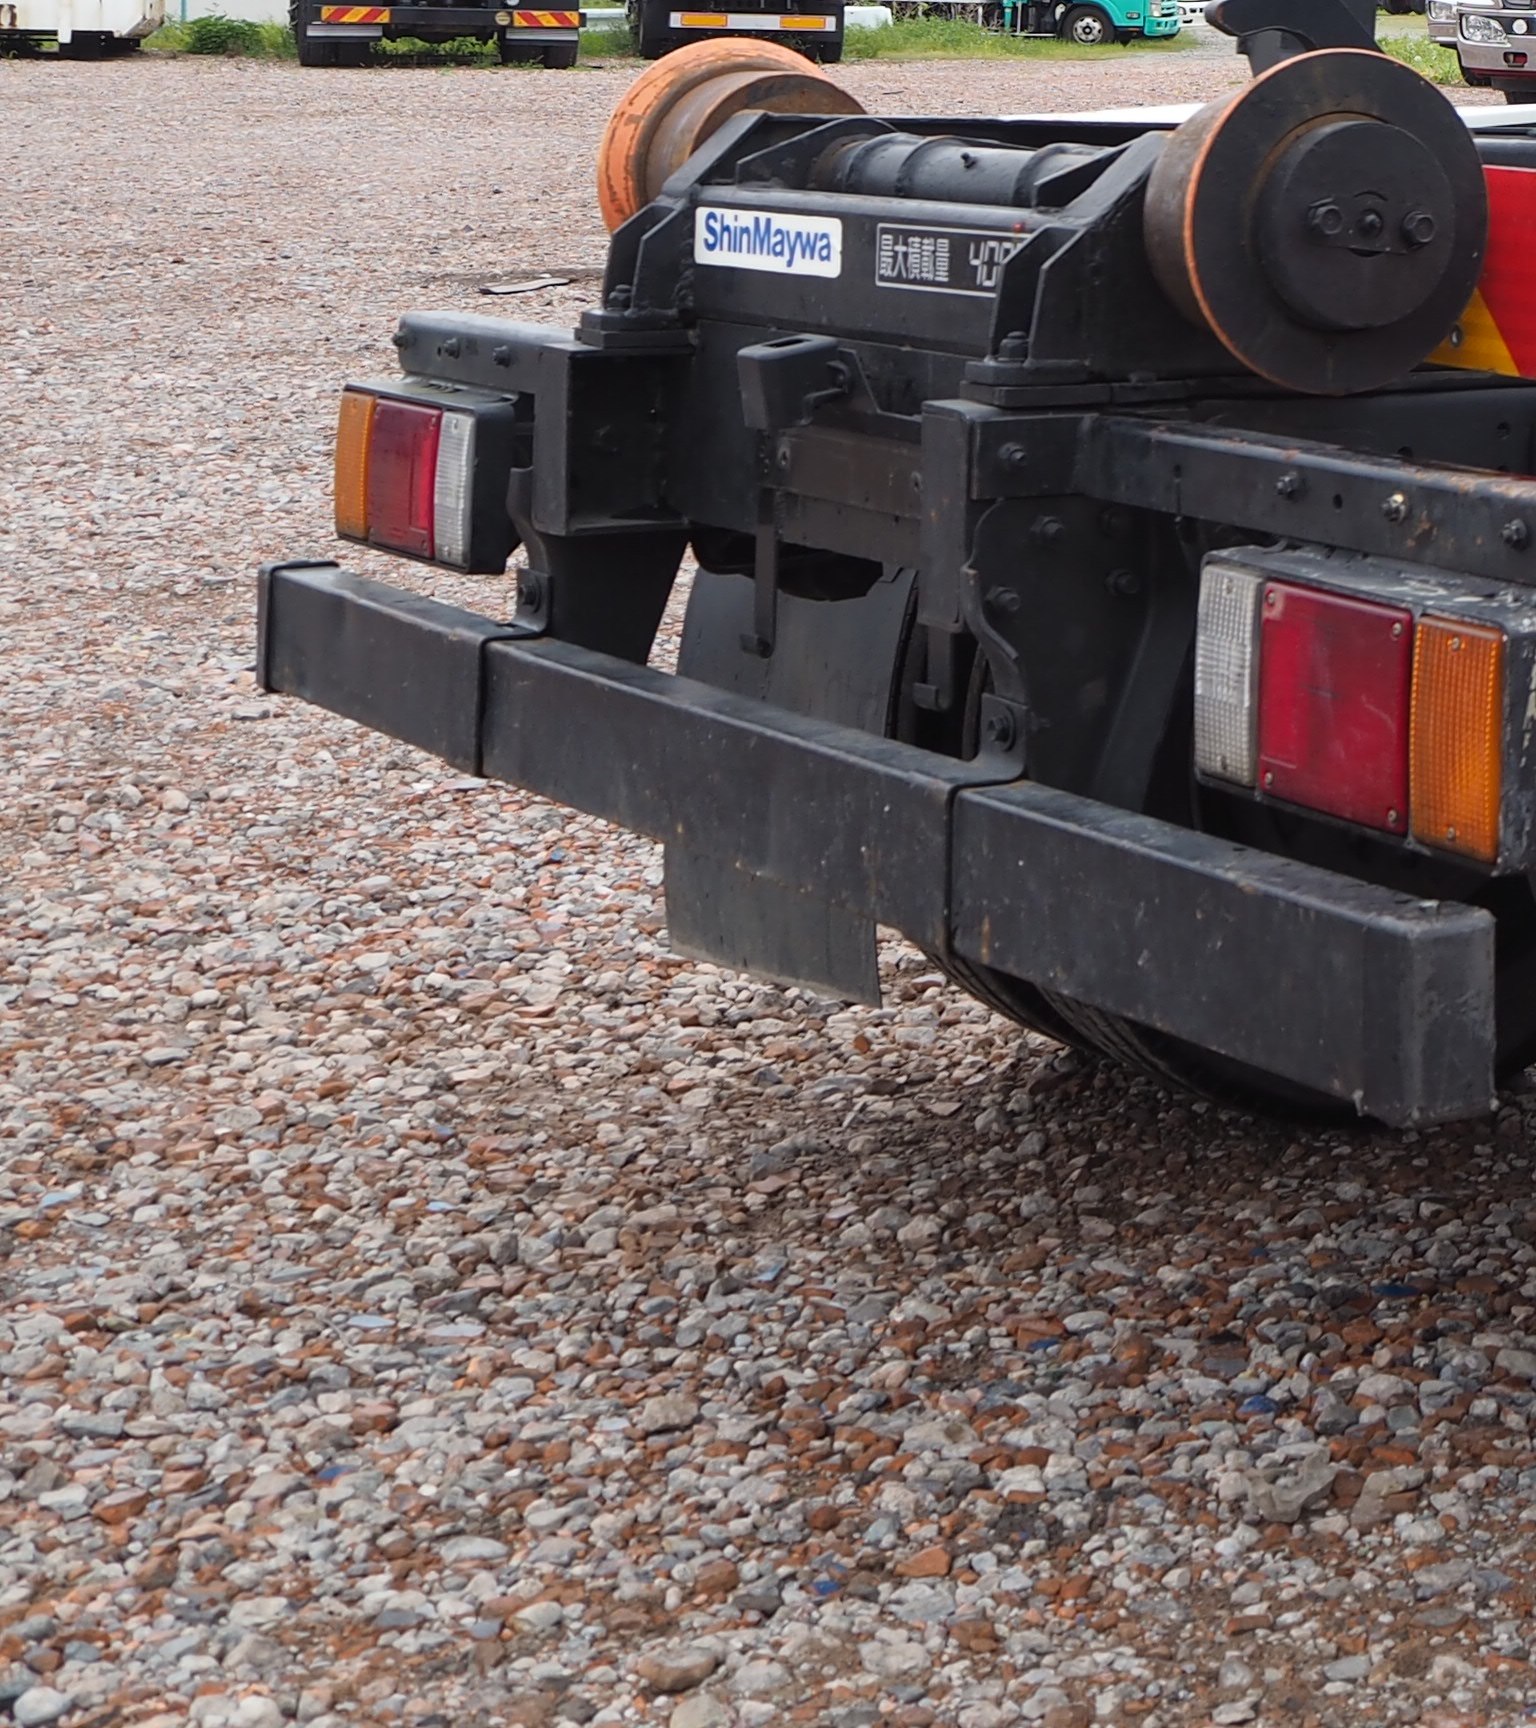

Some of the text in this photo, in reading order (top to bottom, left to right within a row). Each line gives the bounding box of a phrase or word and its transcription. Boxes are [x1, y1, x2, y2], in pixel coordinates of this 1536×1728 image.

[703, 211, 832, 268] ShinMaywa
[879, 233, 1024, 288] 最大積載量 40
